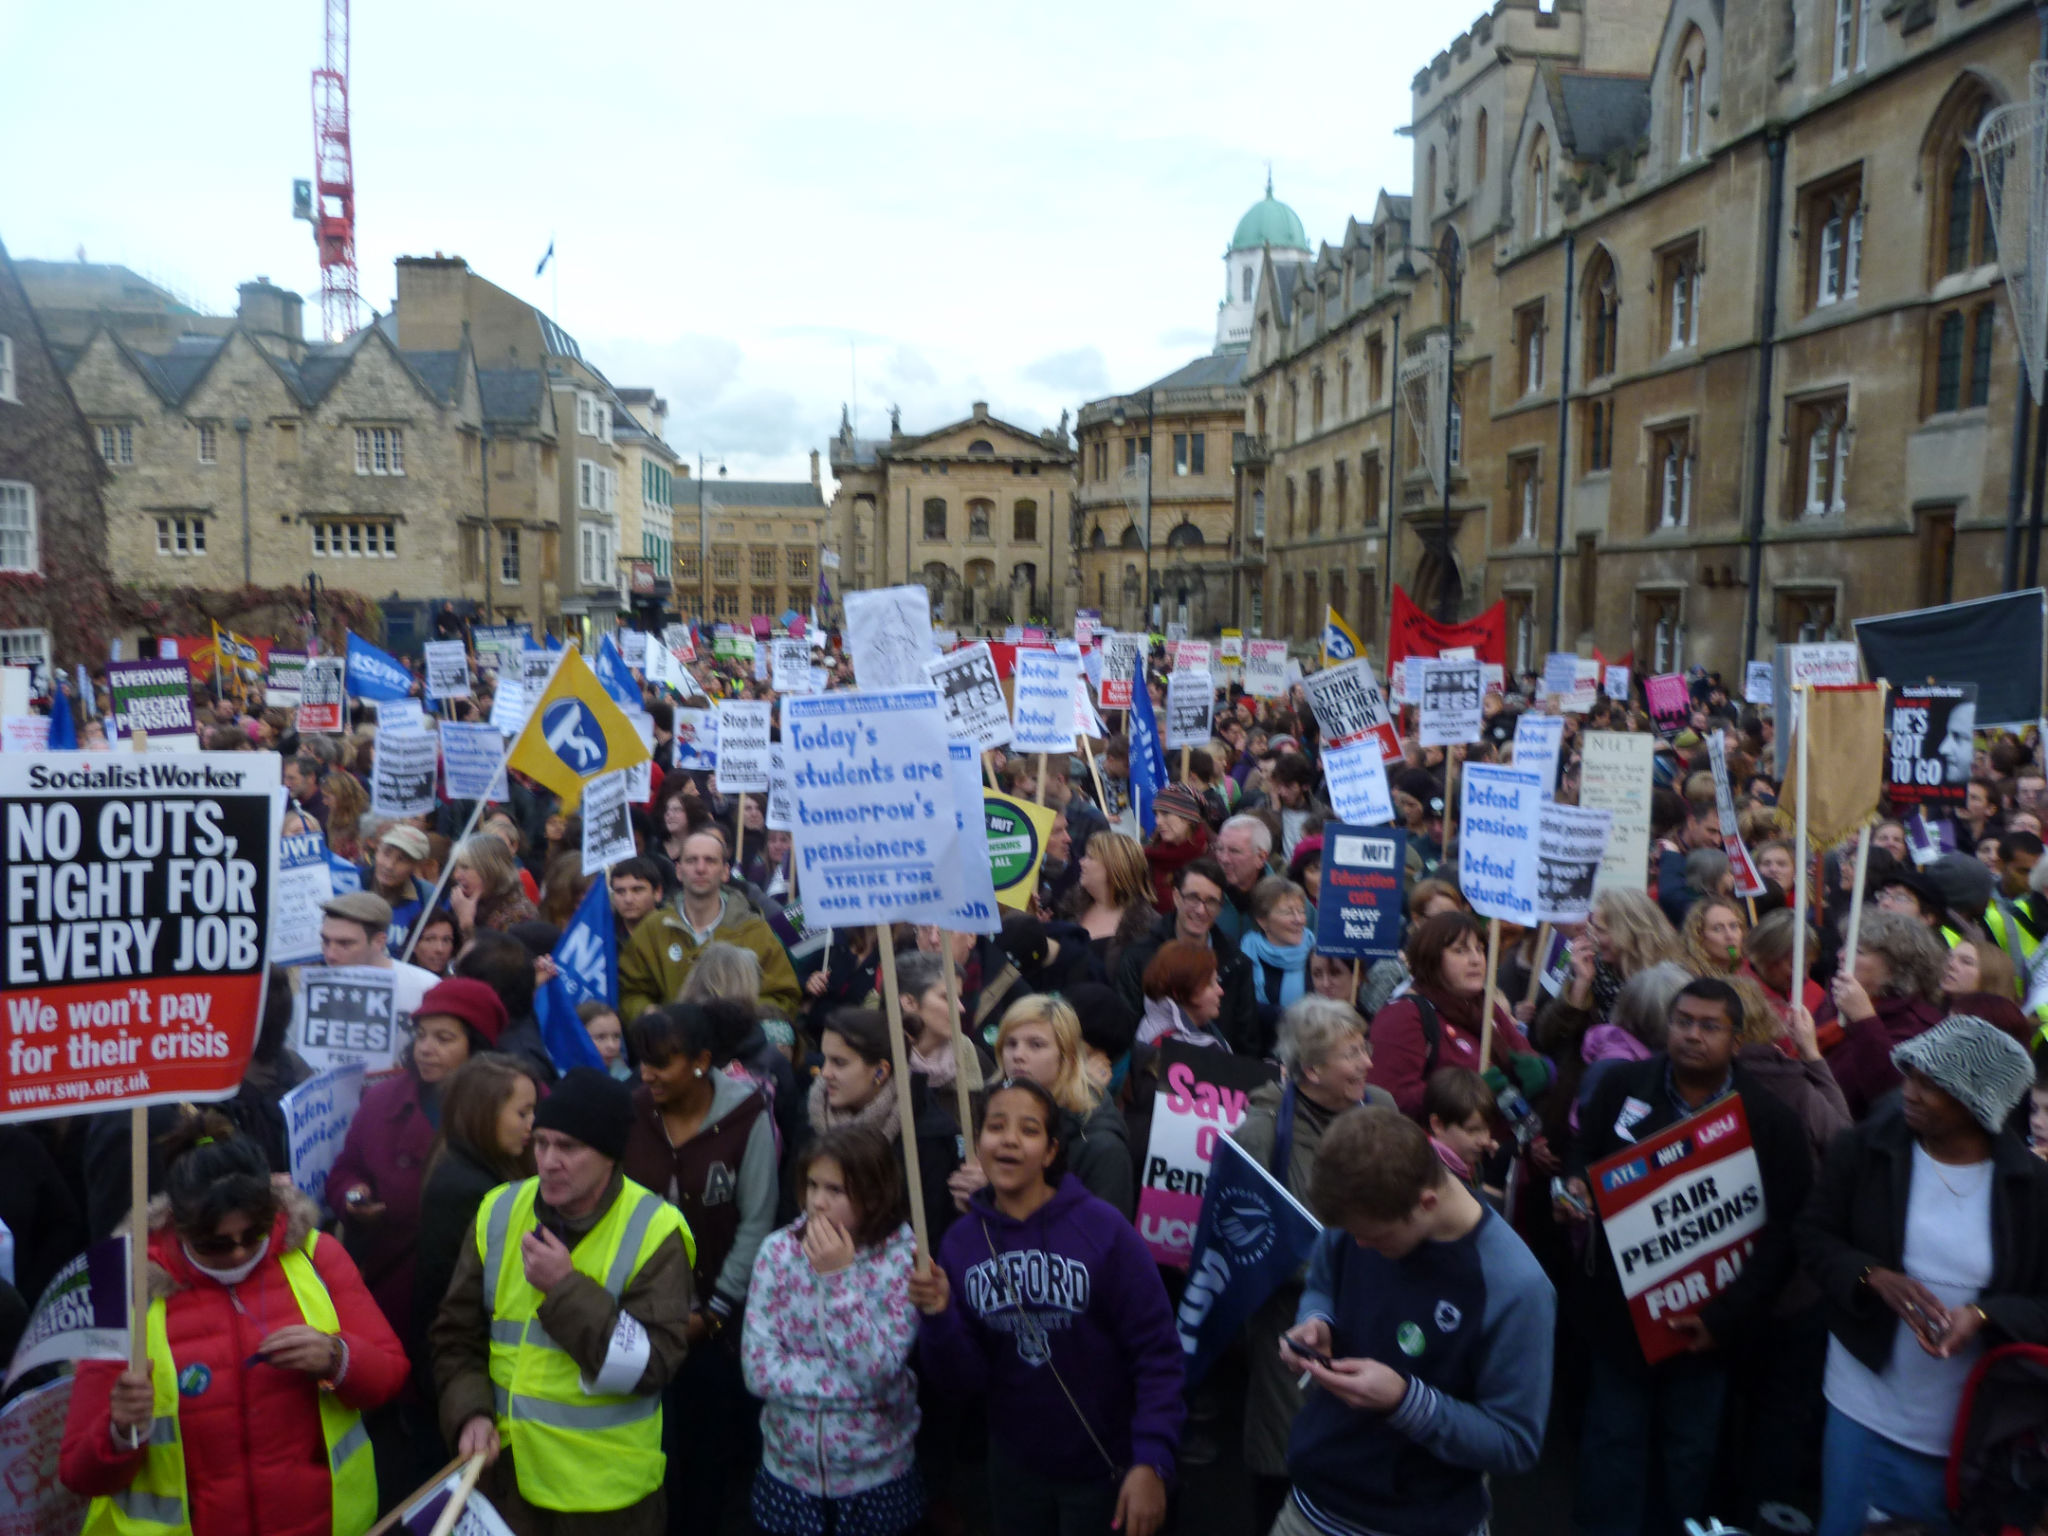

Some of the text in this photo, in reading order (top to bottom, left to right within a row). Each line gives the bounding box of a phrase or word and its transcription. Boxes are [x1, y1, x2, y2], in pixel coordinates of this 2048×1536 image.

[110, 667, 189, 687] EVERYONE
[1313, 675, 1365, 700] STRIKE
[128, 695, 190, 713] DECENT
[1315, 689, 1382, 723] TOGETHER
[115, 712, 192, 731] PENSION
[1350, 709, 1378, 732] WIN
[1892, 707, 1929, 735] HE'S
[790, 718, 877, 757] Today's
[1891, 734, 1924, 759] GOT
[30, 763, 246, 790] Socialist Worker
[795, 757, 943, 789] students are
[1890, 758, 1942, 786] TO GO
[798, 790, 936, 826] tomorrow's
[1467, 781, 1520, 810] Defend
[8, 800, 239, 862] NO CUTS,
[990, 816, 1014, 833] NUT
[1465, 814, 1529, 840] pensions
[803, 834, 928, 871] pensioners
[1361, 843, 1391, 863] NUT
[1464, 849, 1515, 880] Defend
[8, 861, 154, 923] FIGHT
[167, 857, 257, 914] FOR
[825, 869, 935, 890] STRIKE FOR
[1330, 868, 1397, 890] Education
[819, 887, 943, 911] OUR FUTURE
[1464, 880, 1532, 913] education
[1340, 907, 1382, 922] never
[1343, 920, 1376, 940] heal
[8, 915, 259, 984] EVERY JOB
[8, 988, 212, 1035] We won't pay
[9, 1023, 230, 1076] for their crisis
[306, 1017, 388, 1051] FEES
[8, 1069, 150, 1105] www.swp.org.uk
[1610, 1163, 1640, 1188] ATL
[1656, 1139, 1685, 1168] NUT
[1650, 1175, 1720, 1228] FAIR
[1620, 1185, 1760, 1276] PENSIONS
[965, 1249, 1090, 1319] OXFORD
[1644, 1270, 1712, 1321] FOR
